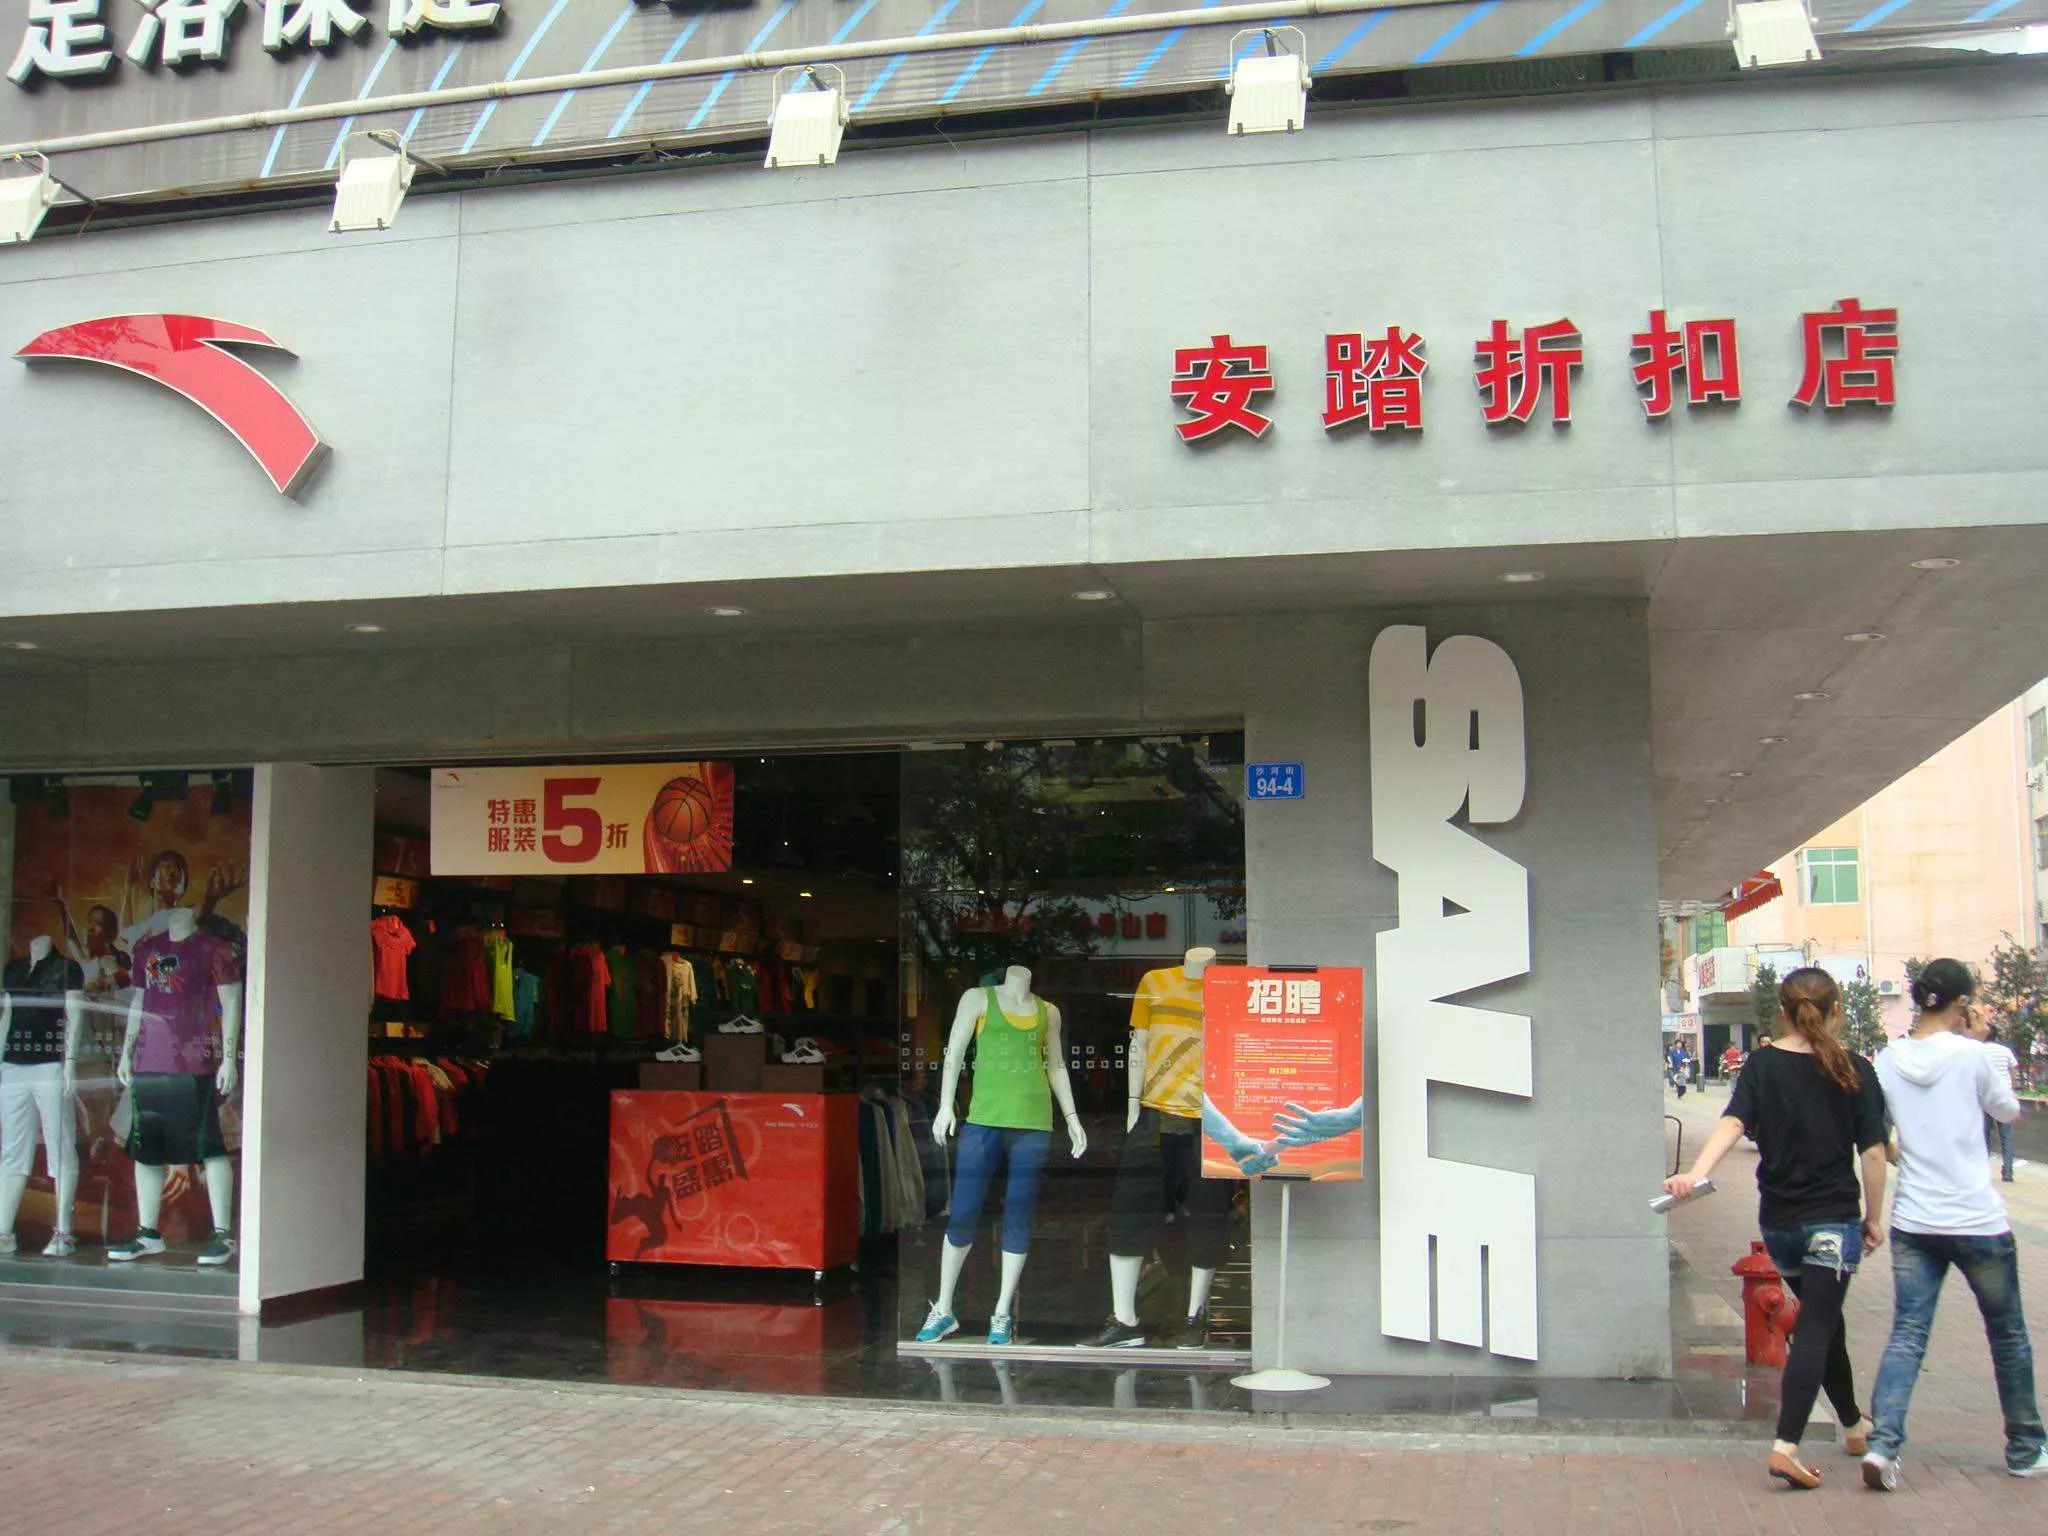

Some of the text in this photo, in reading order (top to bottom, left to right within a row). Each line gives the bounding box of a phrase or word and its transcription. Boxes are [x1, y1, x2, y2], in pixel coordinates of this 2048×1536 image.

[1171, 298, 1899, 443] 安踏折扣店
[1256, 776, 1294, 796] 94-4
[487, 799, 536, 825] 特惠
[487, 827, 536, 853] 服装
[1247, 979, 1321, 1015] 招聘
[1369, 624, 1538, 1361] SALE
